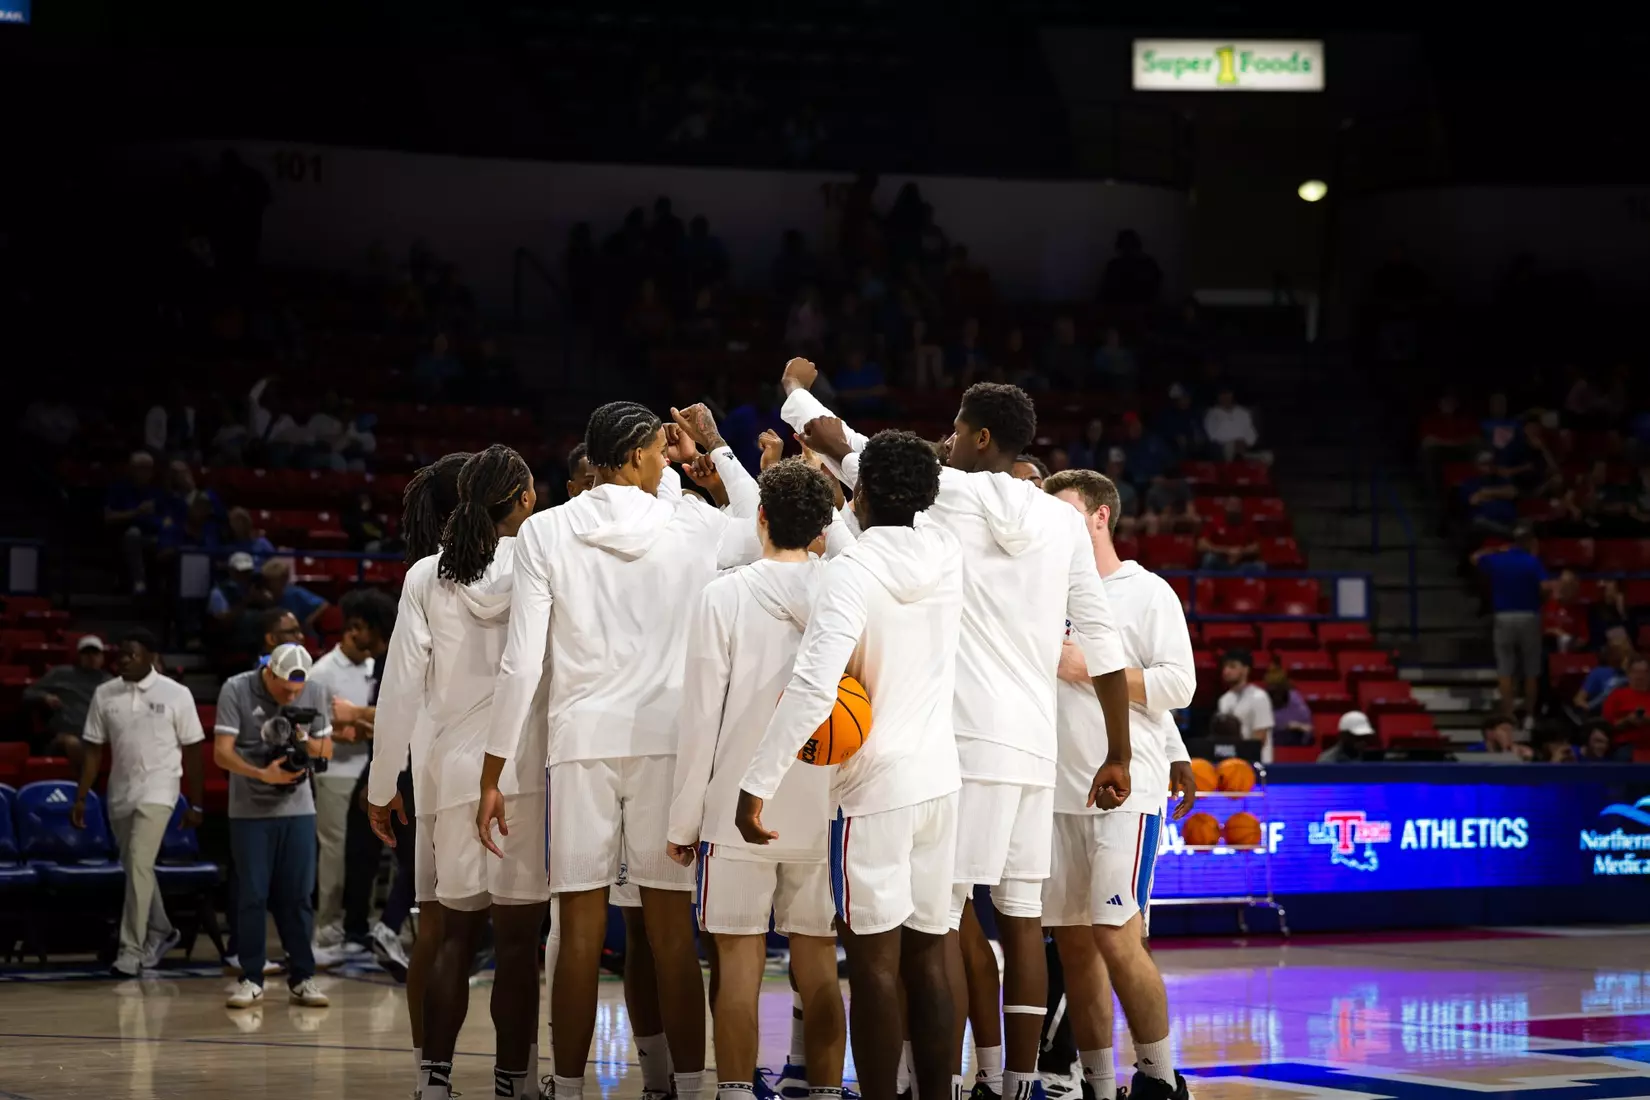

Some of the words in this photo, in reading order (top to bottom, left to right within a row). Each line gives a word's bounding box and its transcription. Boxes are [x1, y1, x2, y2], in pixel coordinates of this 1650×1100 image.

[1142, 49, 1212, 79] Super
[1215, 45, 1237, 84] 1
[1240, 51, 1311, 73] Foods
[1400, 817, 1529, 850] ATHLETICS
